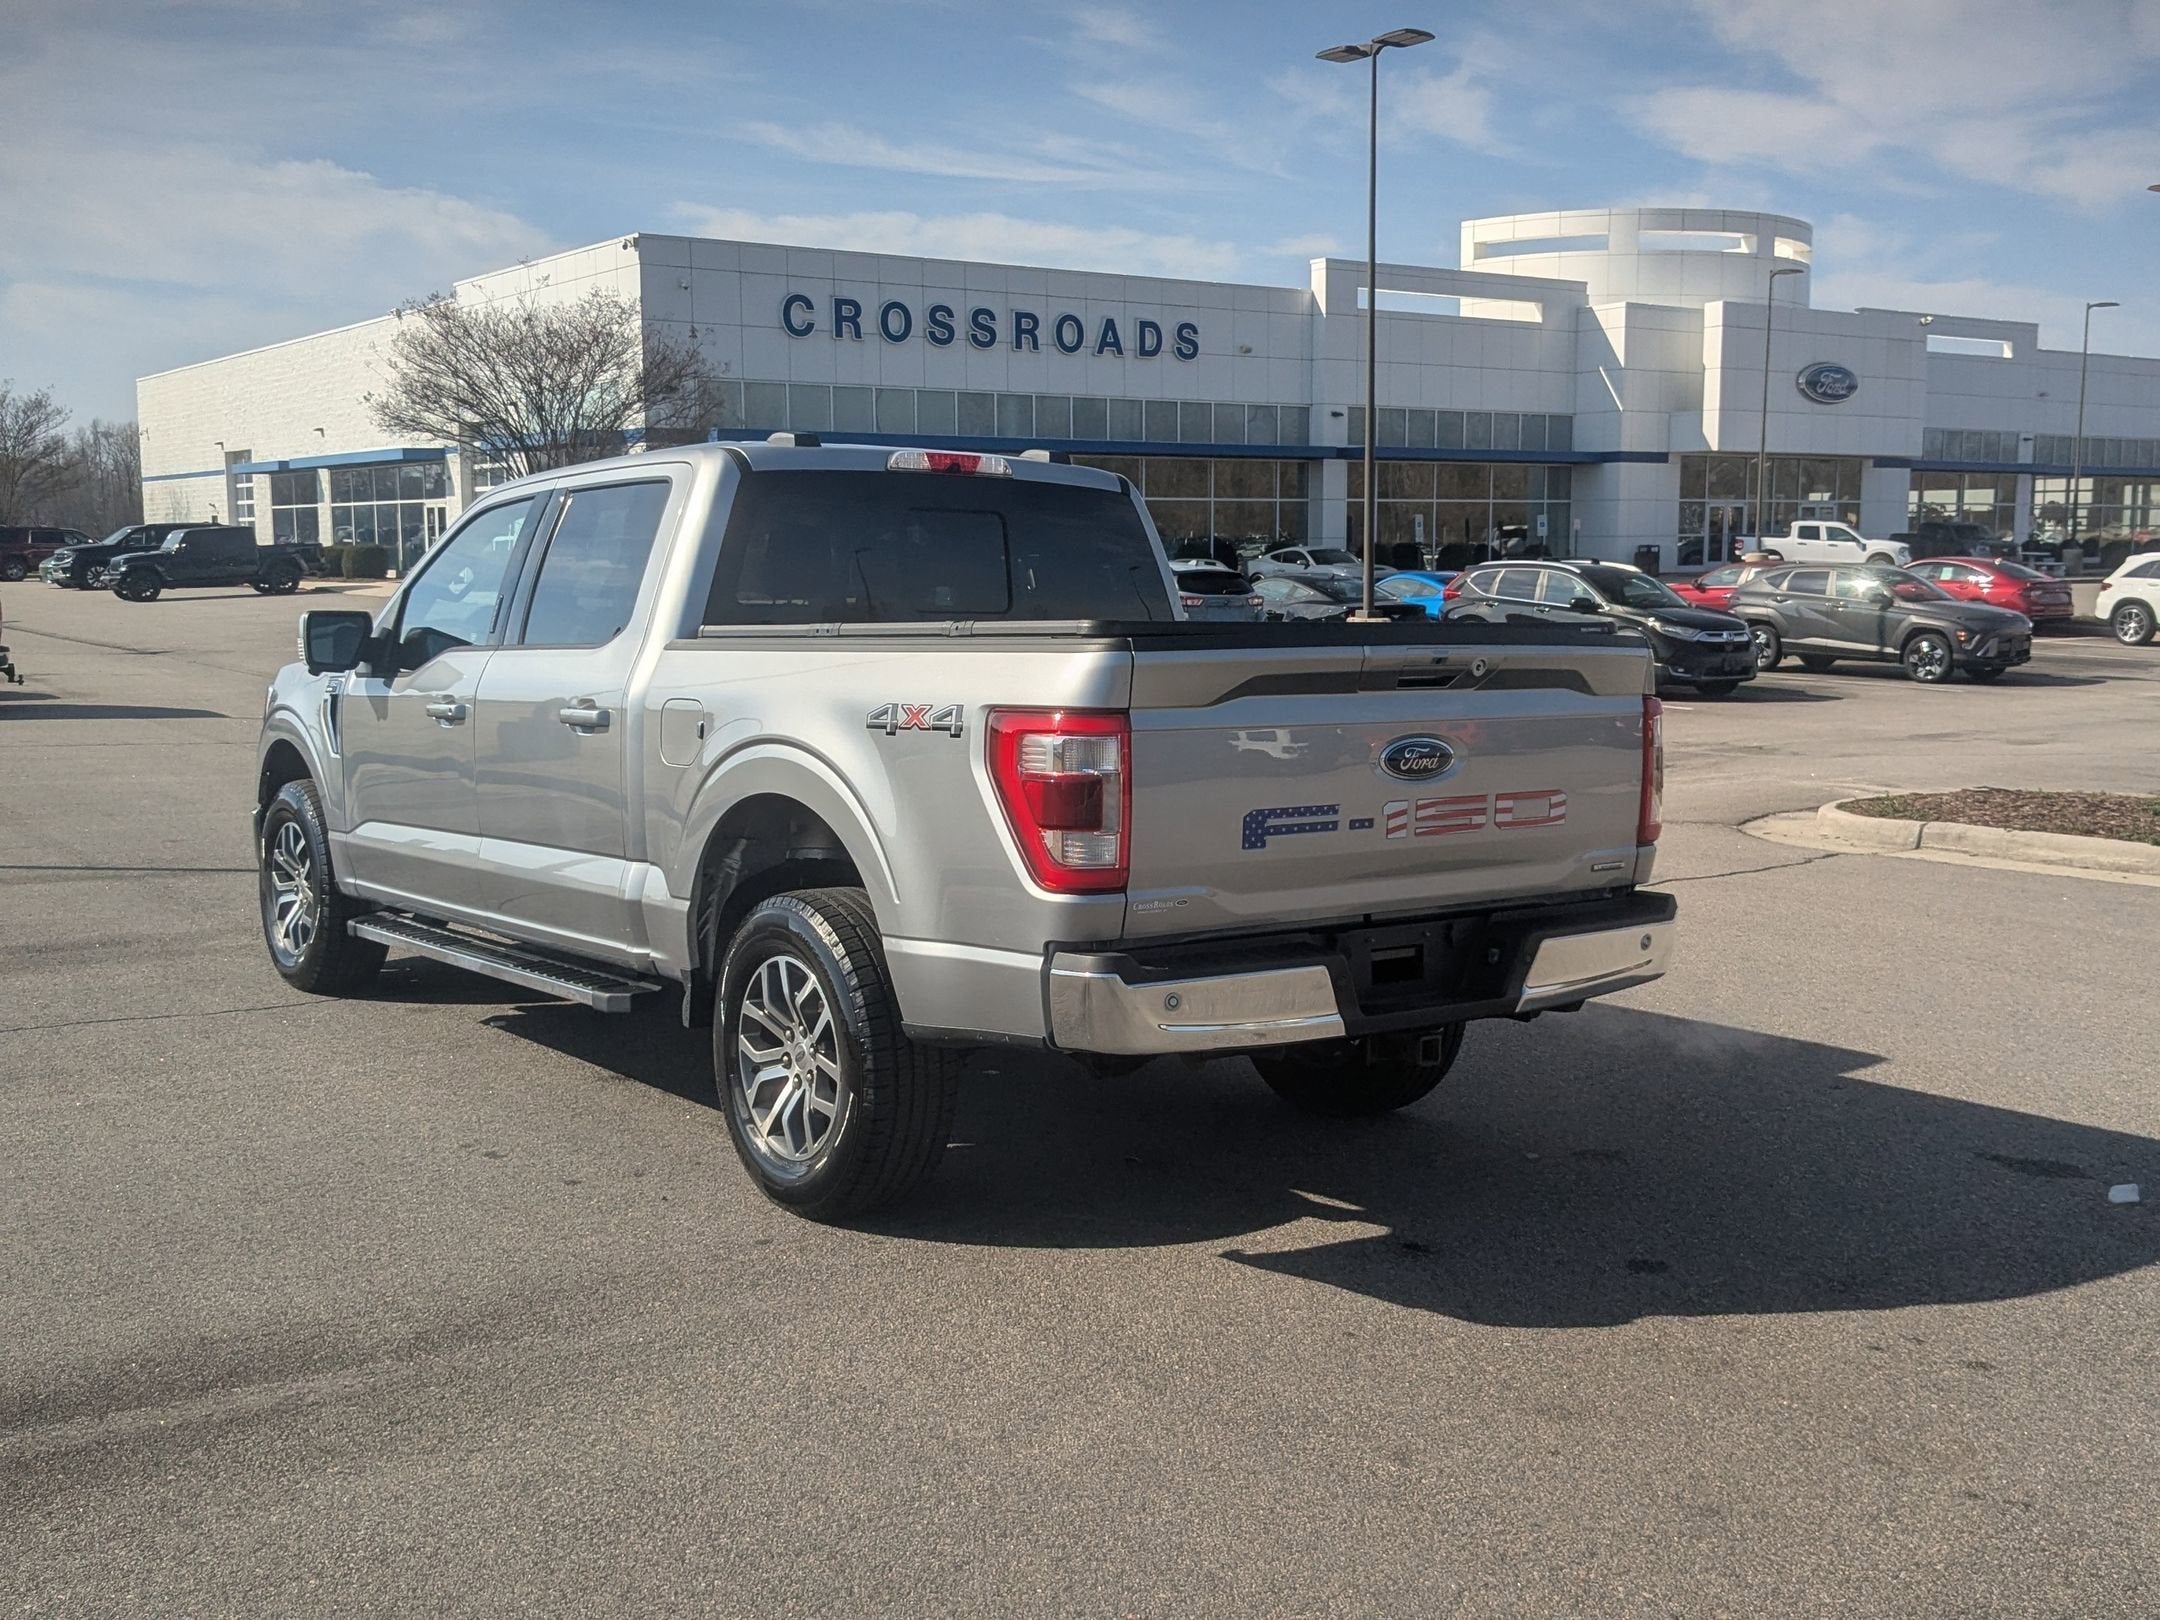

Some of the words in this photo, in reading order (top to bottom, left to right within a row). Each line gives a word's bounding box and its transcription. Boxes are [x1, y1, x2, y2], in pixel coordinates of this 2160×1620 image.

[781, 293, 1200, 362] CROSSROADS
[1816, 372, 1850, 394] Ford
[1400, 747, 1440, 770] Ford
[1242, 789, 1568, 850] F-150
